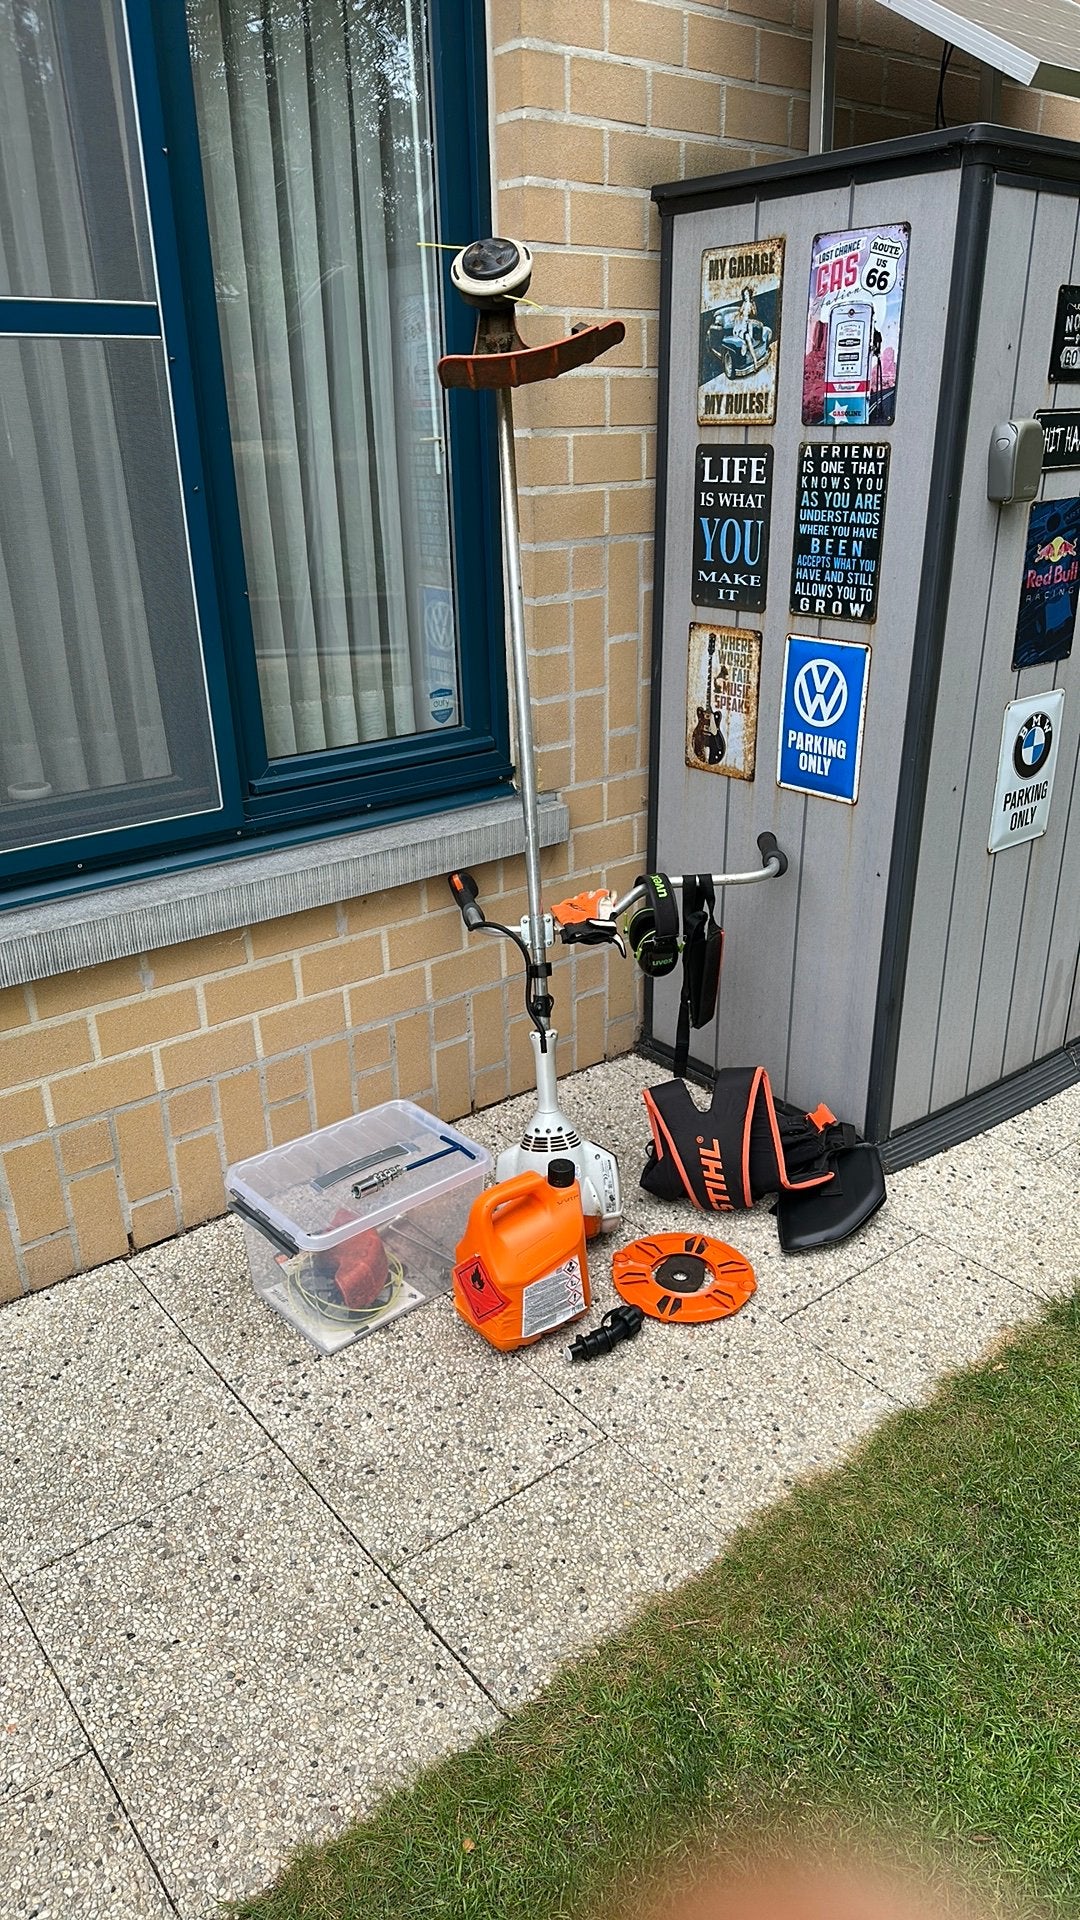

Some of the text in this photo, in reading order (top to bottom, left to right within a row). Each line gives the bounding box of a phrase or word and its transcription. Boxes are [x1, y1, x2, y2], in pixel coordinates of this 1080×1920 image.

[819, 239, 862, 264] LAST CHANCE
[872, 242, 901, 256] ROUTE
[708, 251, 775, 281] MY GARAGE
[876, 258, 888, 268] US
[816, 252, 859, 298] GAS
[866, 268, 890, 290] 66
[704, 392, 769, 415] MY RULES!
[1042, 426, 1065, 454] HIT
[804, 445, 886, 459] A FRIEND
[703, 457, 767, 484] LIFE
[802, 461, 885, 475] IS ONE THAT
[801, 476, 883, 491] KNOWS YOU
[700, 492, 765, 508] IS WHAT
[801, 491, 881, 510] AS YOU ARE
[800, 509, 880, 525] UNDERSTANDS
[799, 524, 878, 539] WHERE YOU HAVE
[700, 517, 764, 566] YOU
[810, 537, 863, 557] BEEN
[796, 554, 876, 572] ACCEPTS WHAT YOU
[698, 570, 761, 587] MAKE
[795, 567, 874, 586] HAVE AND STILL
[1026, 561, 1079, 589] Red Bull
[718, 589, 739, 601] IT
[794, 582, 873, 602] ALLOWS YOU TO
[1026, 585, 1074, 602] RACING
[800, 597, 865, 617] GROW
[720, 635, 753, 653] WHERE
[718, 650, 752, 669] WORDS
[732, 667, 751, 684] FAIL
[722, 681, 751, 699] MUSIC
[714, 695, 750, 714] SPEAKS
[1019, 714, 1052, 739] BMW
[787, 729, 847, 760] PARKING
[798, 752, 832, 777] ONLY
[1002, 780, 1048, 812] PARKING
[1009, 805, 1037, 831] ONLY
[652, 957, 673, 966] uvex
